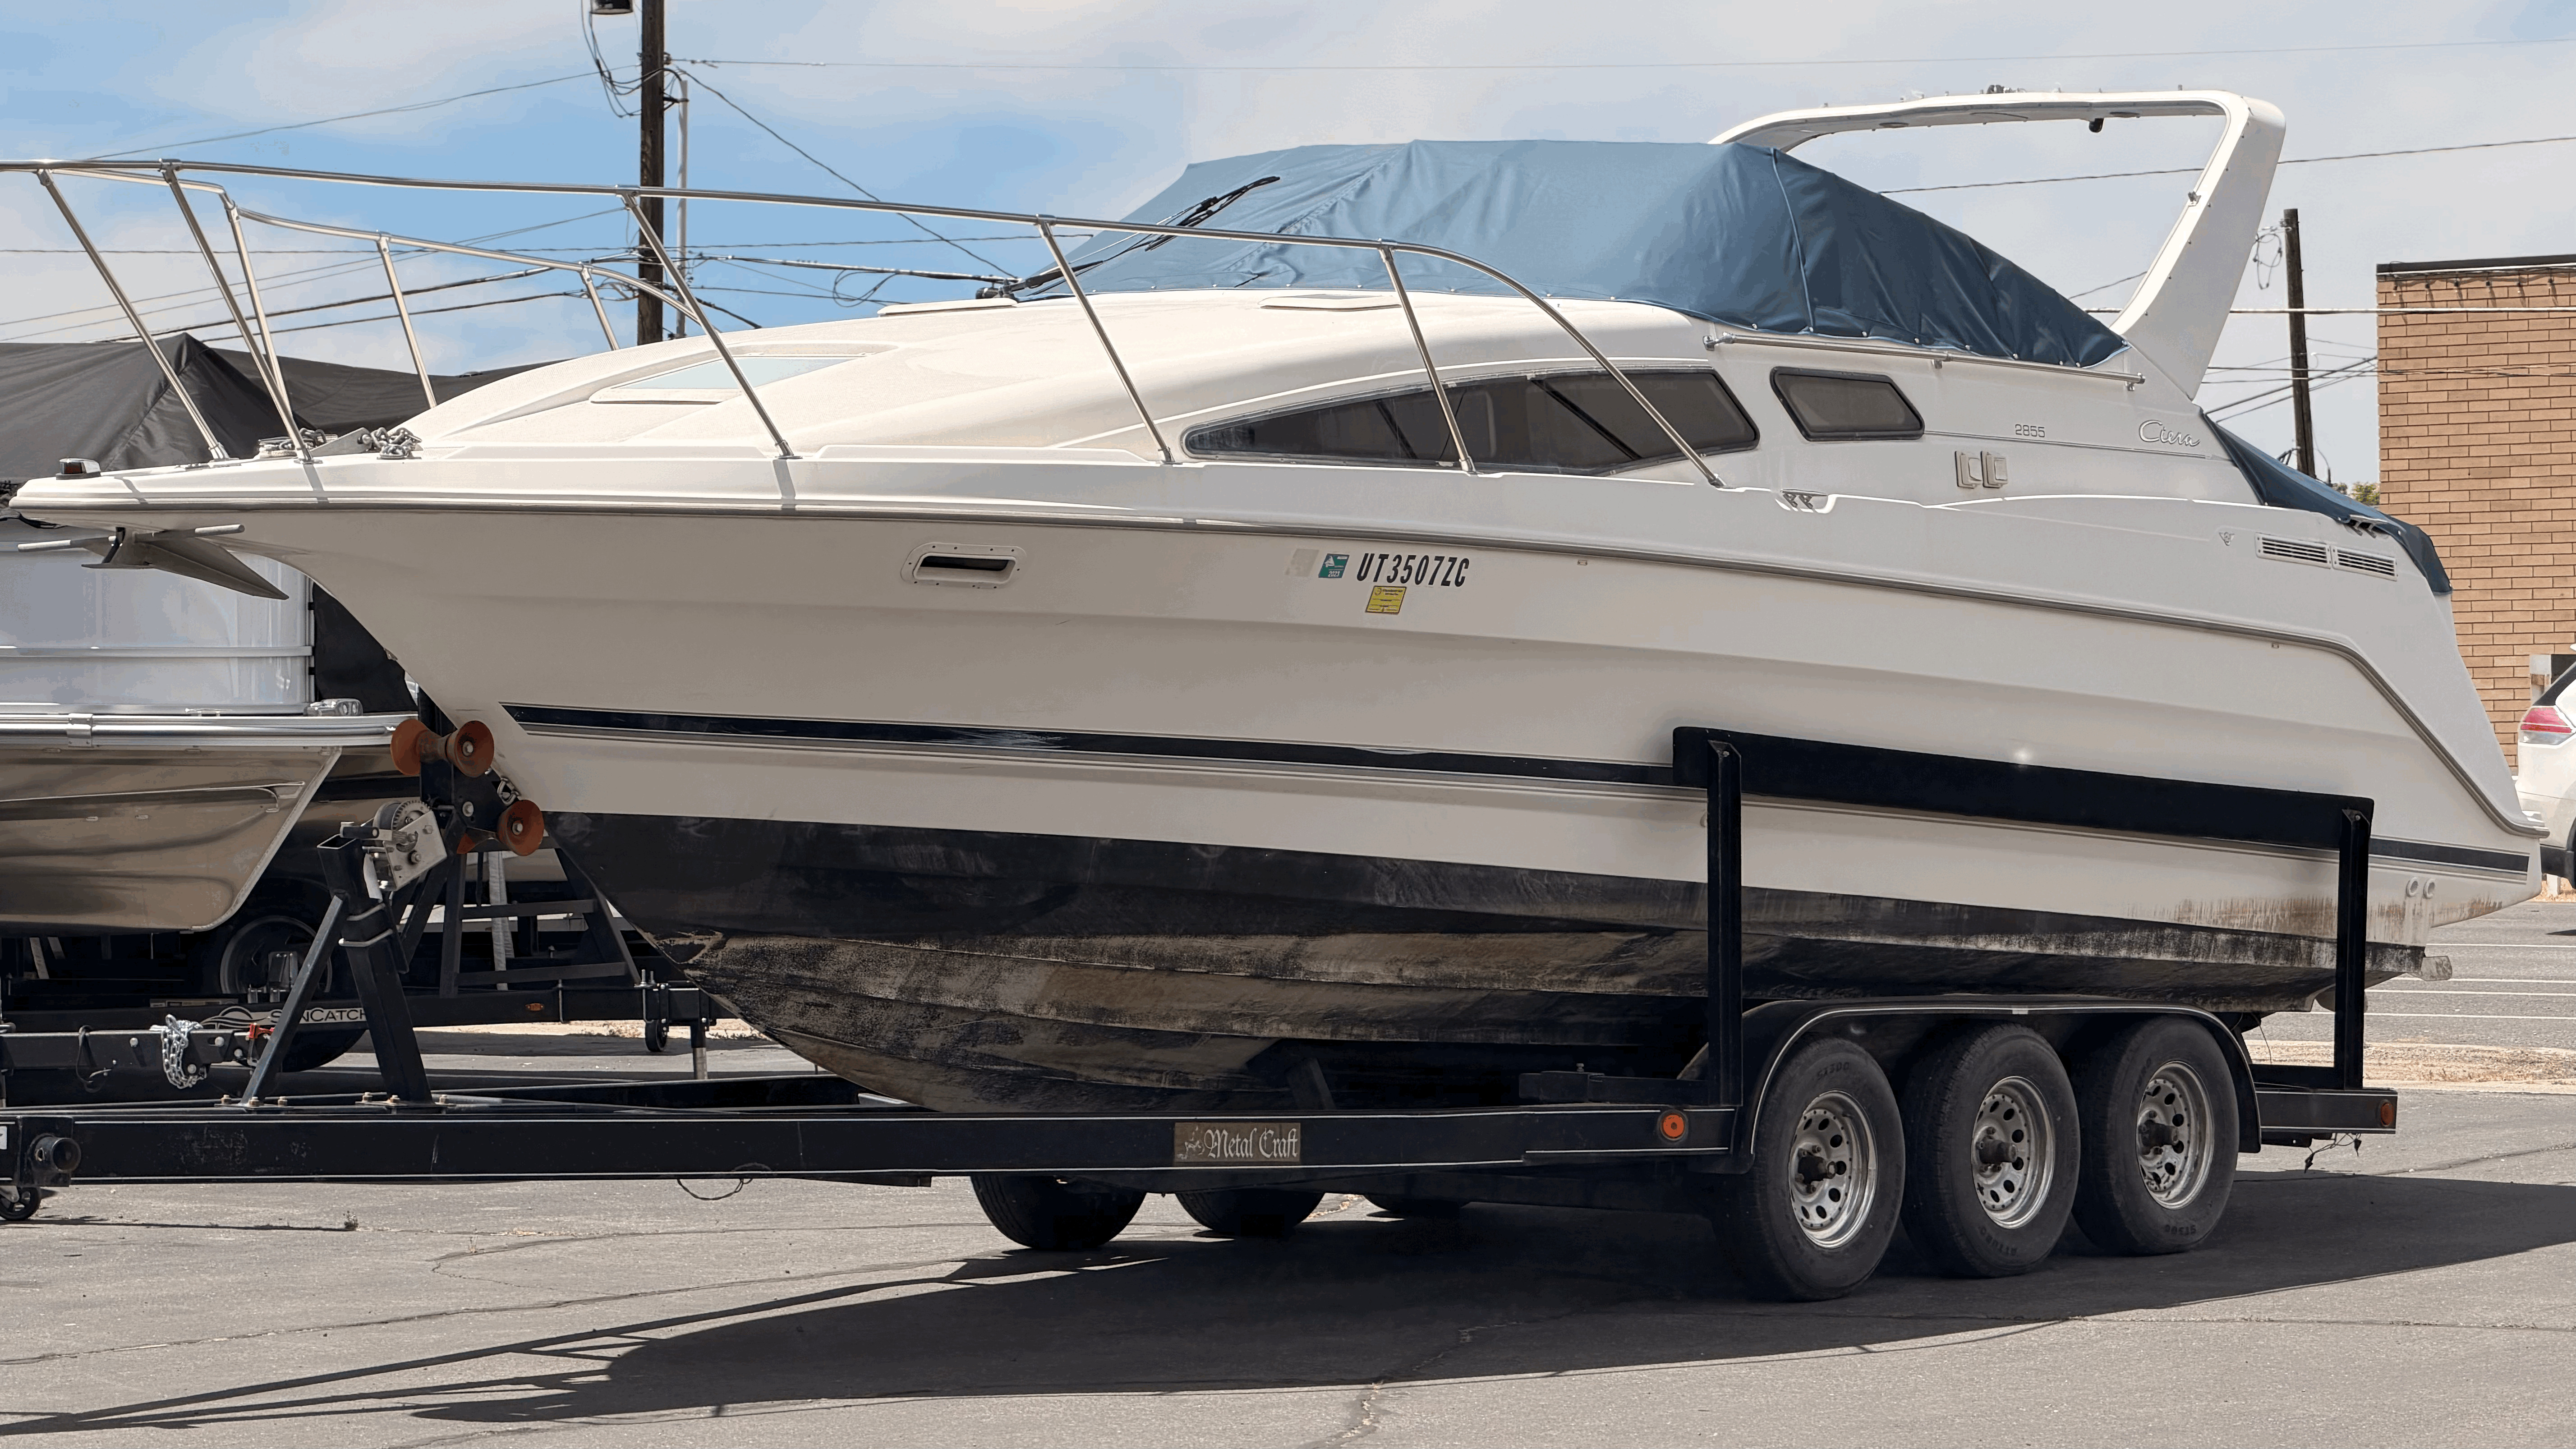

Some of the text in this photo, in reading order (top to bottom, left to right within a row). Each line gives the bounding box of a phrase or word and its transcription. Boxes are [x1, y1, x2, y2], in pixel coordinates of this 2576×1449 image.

[2015, 424, 2045, 437] 2855
[2138, 419, 2201, 447] Ciera
[1357, 553, 1470, 587] UT3507ZC
[1204, 1128, 1257, 1159] Metal
[1259, 1127, 1298, 1159] Craft
